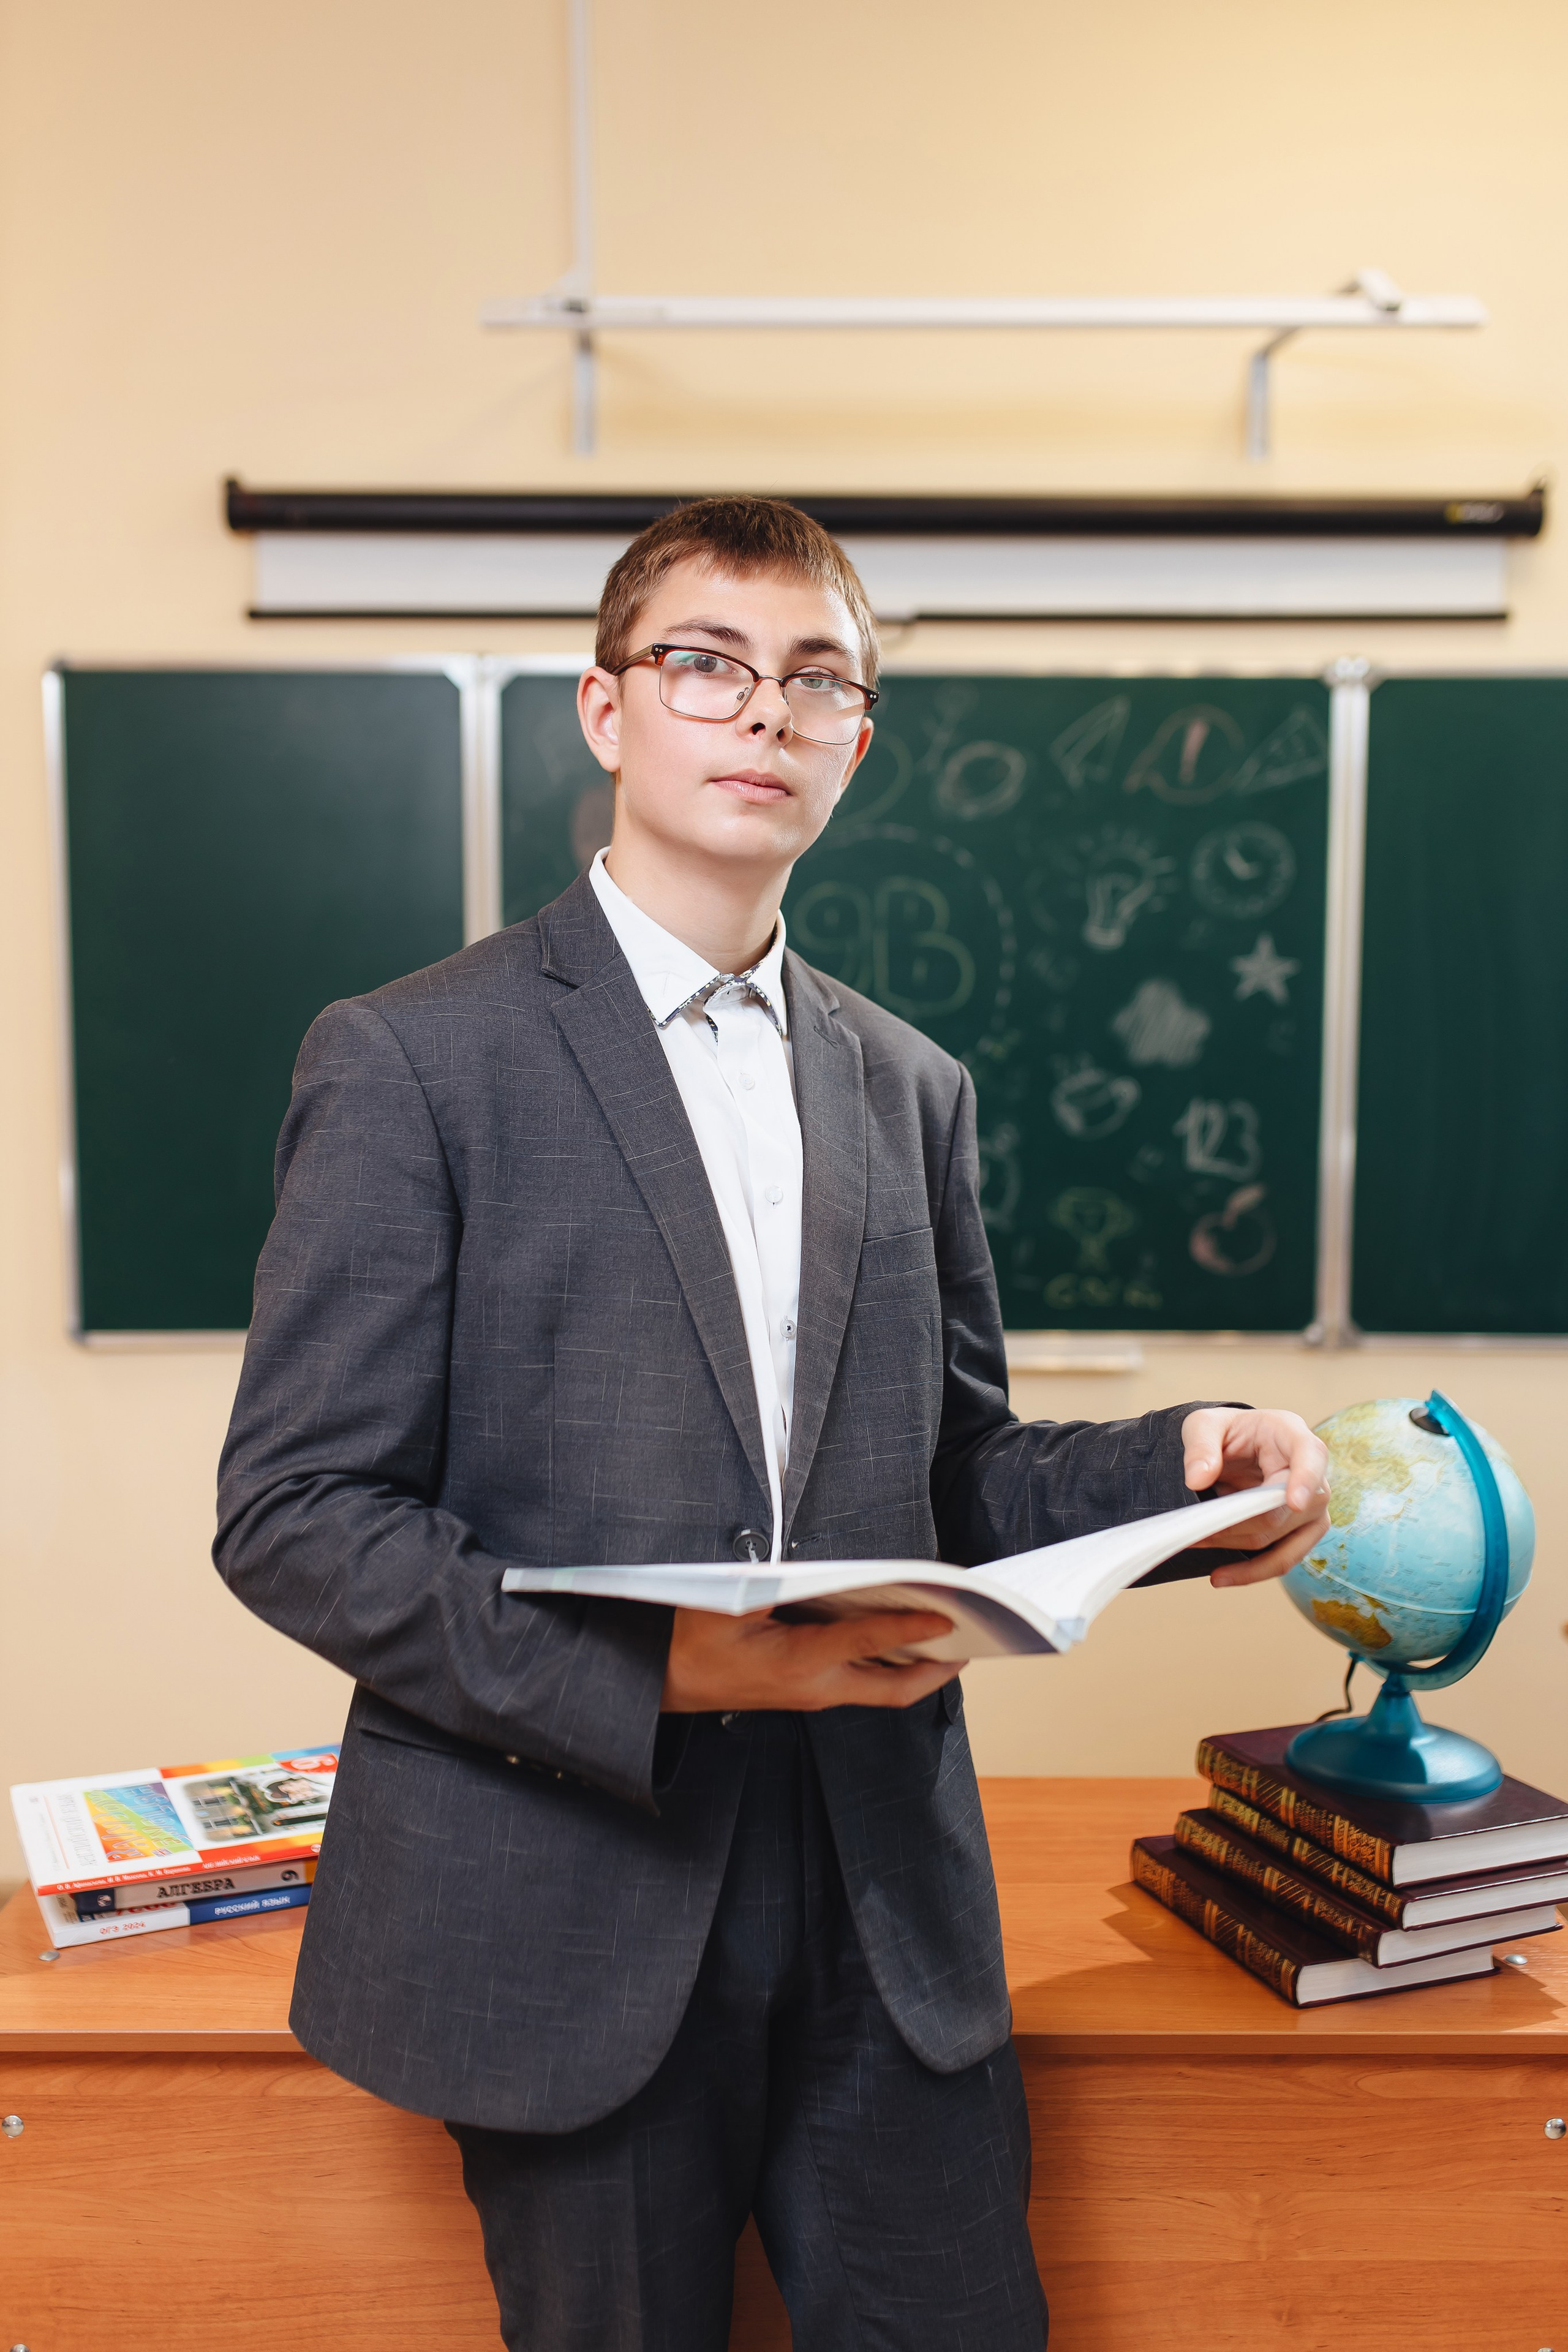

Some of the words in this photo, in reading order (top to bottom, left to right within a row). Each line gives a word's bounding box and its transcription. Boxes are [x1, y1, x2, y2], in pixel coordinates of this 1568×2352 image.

[156, 1877, 236, 1899] АЛГЕБРА
[214, 1899, 260, 1916] РУССКИЙ
[261, 1895, 291, 1908] ЯЗЫК
[99, 1925, 119, 1935] ОГЭ
